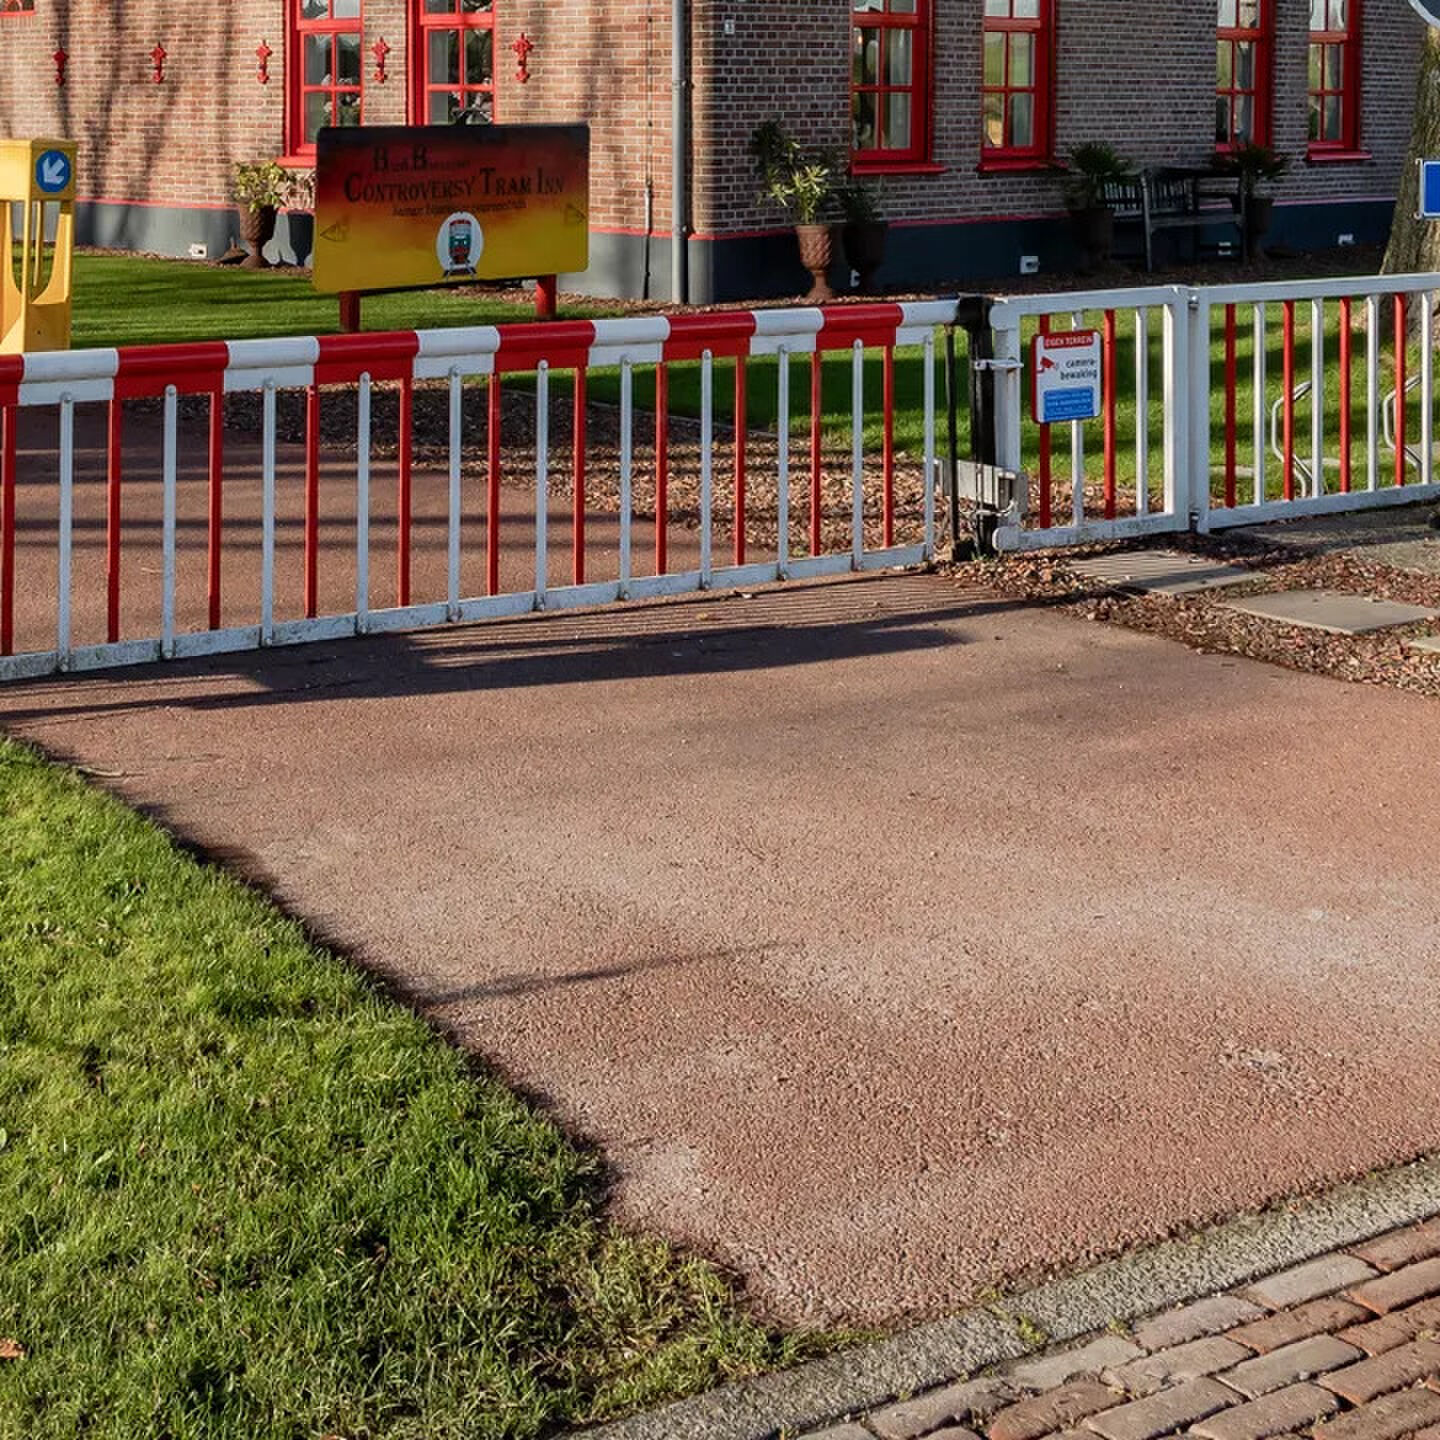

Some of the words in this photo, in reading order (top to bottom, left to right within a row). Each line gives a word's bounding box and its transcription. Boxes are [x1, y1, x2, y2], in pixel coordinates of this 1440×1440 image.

[343, 172, 476, 203] CONTROVERSY
[479, 167, 531, 195] TRAM
[536, 167, 565, 194] INN
